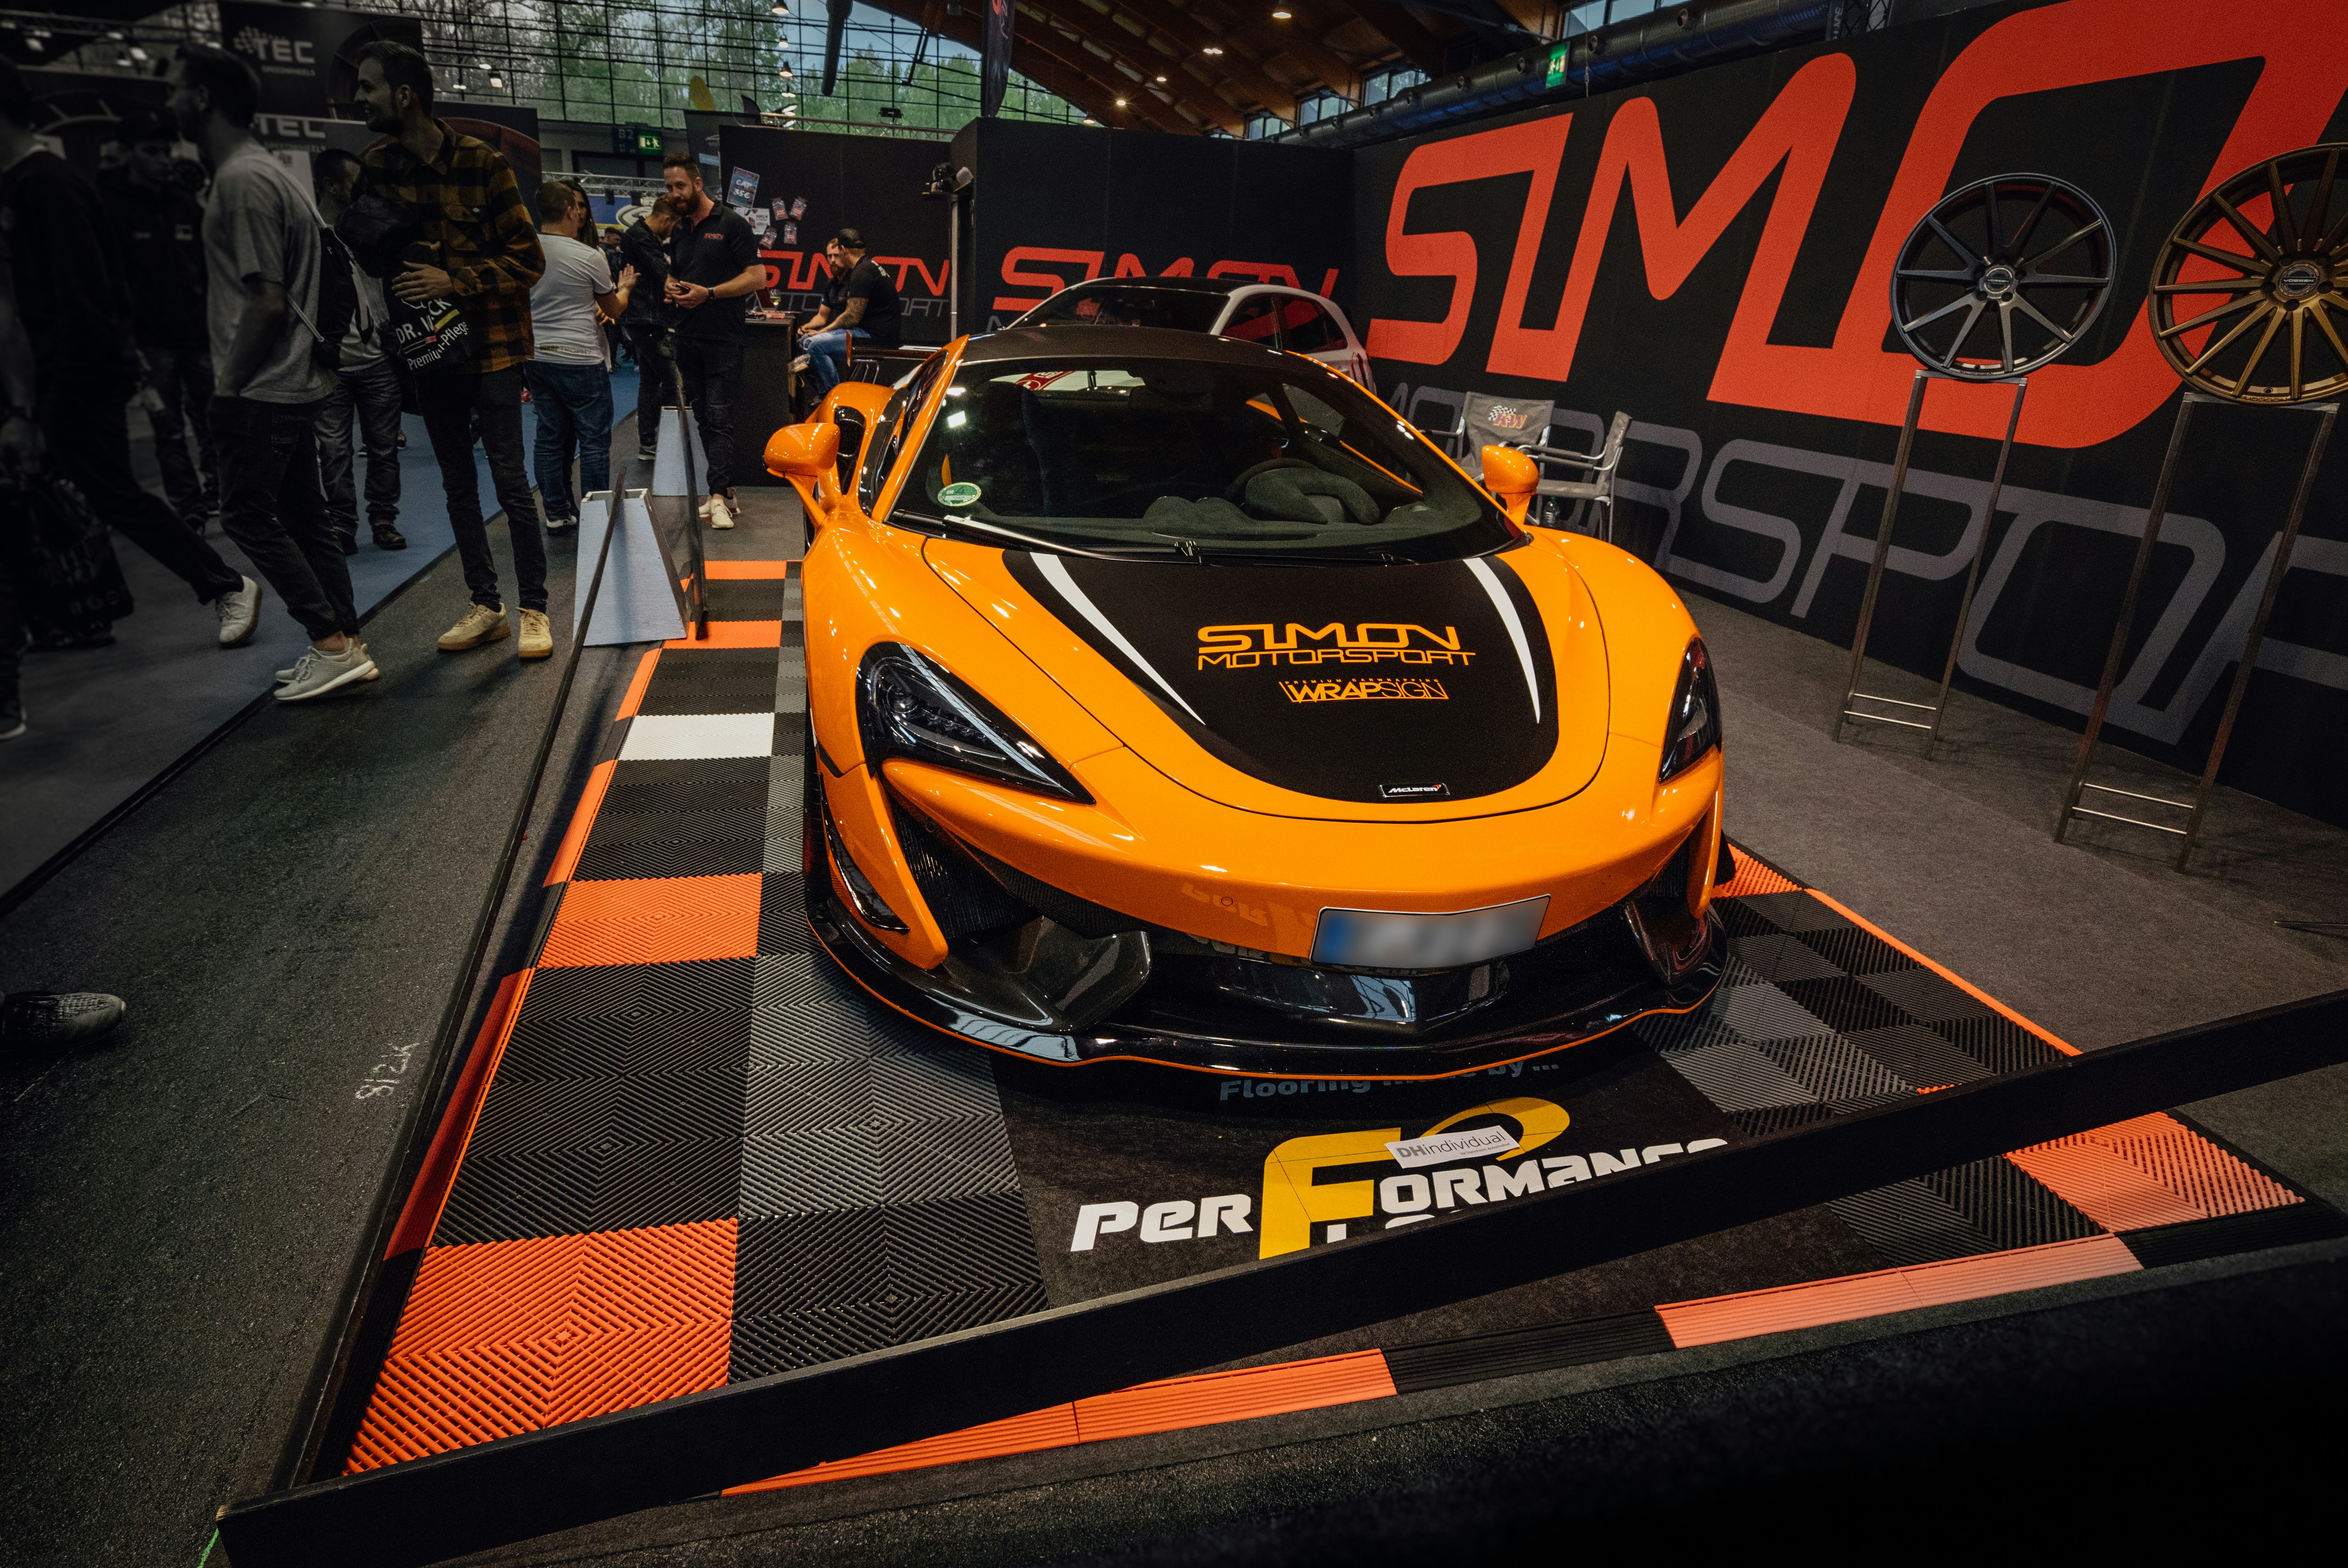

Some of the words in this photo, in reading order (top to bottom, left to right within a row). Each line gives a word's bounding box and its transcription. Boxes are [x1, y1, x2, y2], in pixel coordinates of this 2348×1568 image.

[252, 38, 315, 63] TEC
[1367, 0, 2348, 449] SIMO
[395, 323, 422, 344] DR.
[420, 298, 452, 332] WCK
[1493, 413, 1527, 429] KW
[1198, 622, 1460, 654] SIMON
[1198, 649, 1476, 670] MOTORSPORT
[1287, 681, 1448, 703] WRAPSIGN
[1219, 1079, 1371, 1101] Flooring
[1397, 1131, 1506, 1158] DHindividual
